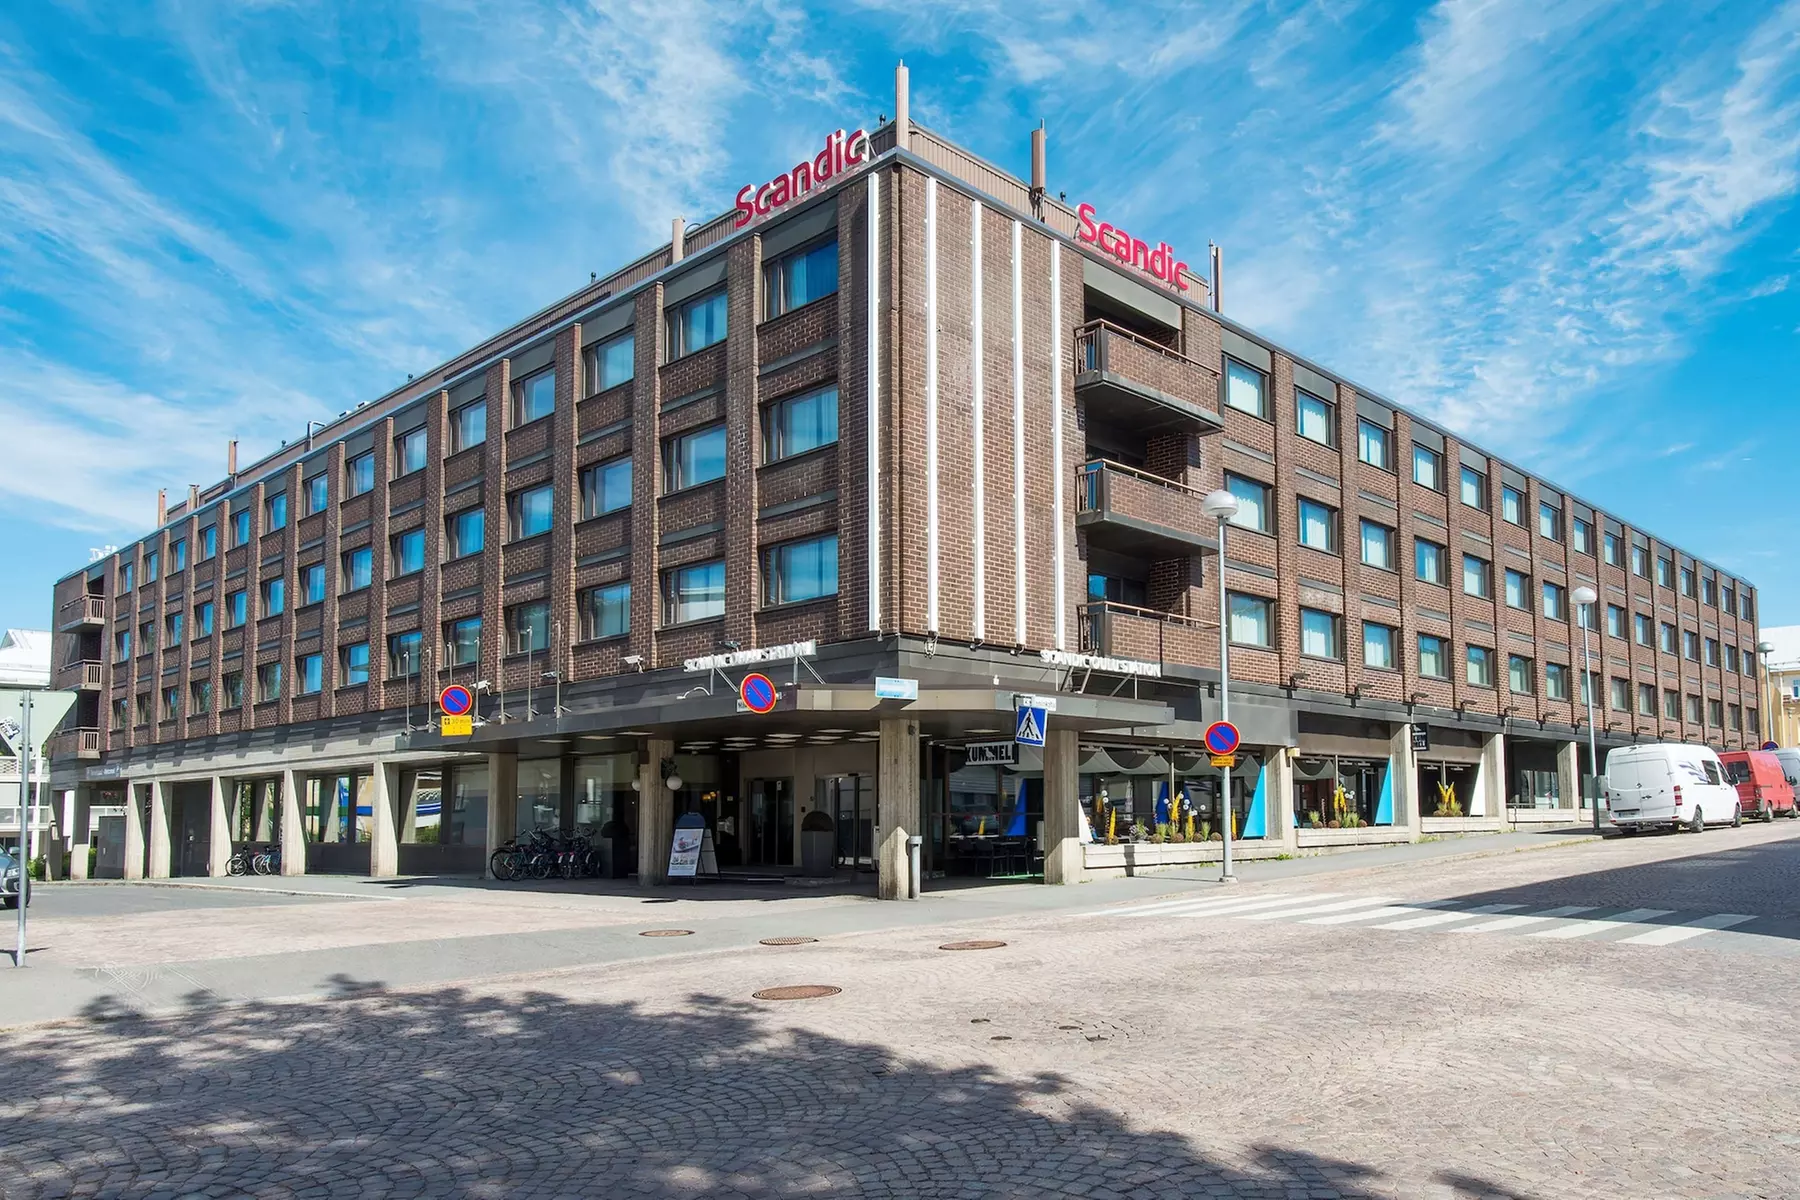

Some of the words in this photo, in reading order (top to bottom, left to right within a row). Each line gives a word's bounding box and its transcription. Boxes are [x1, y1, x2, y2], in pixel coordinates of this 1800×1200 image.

[735, 129, 869, 228] Scandic
[1076, 203, 1188, 291] Scandic
[1040, 650, 1090, 668] SCANDIC
[1119, 660, 1162, 678] STATION
